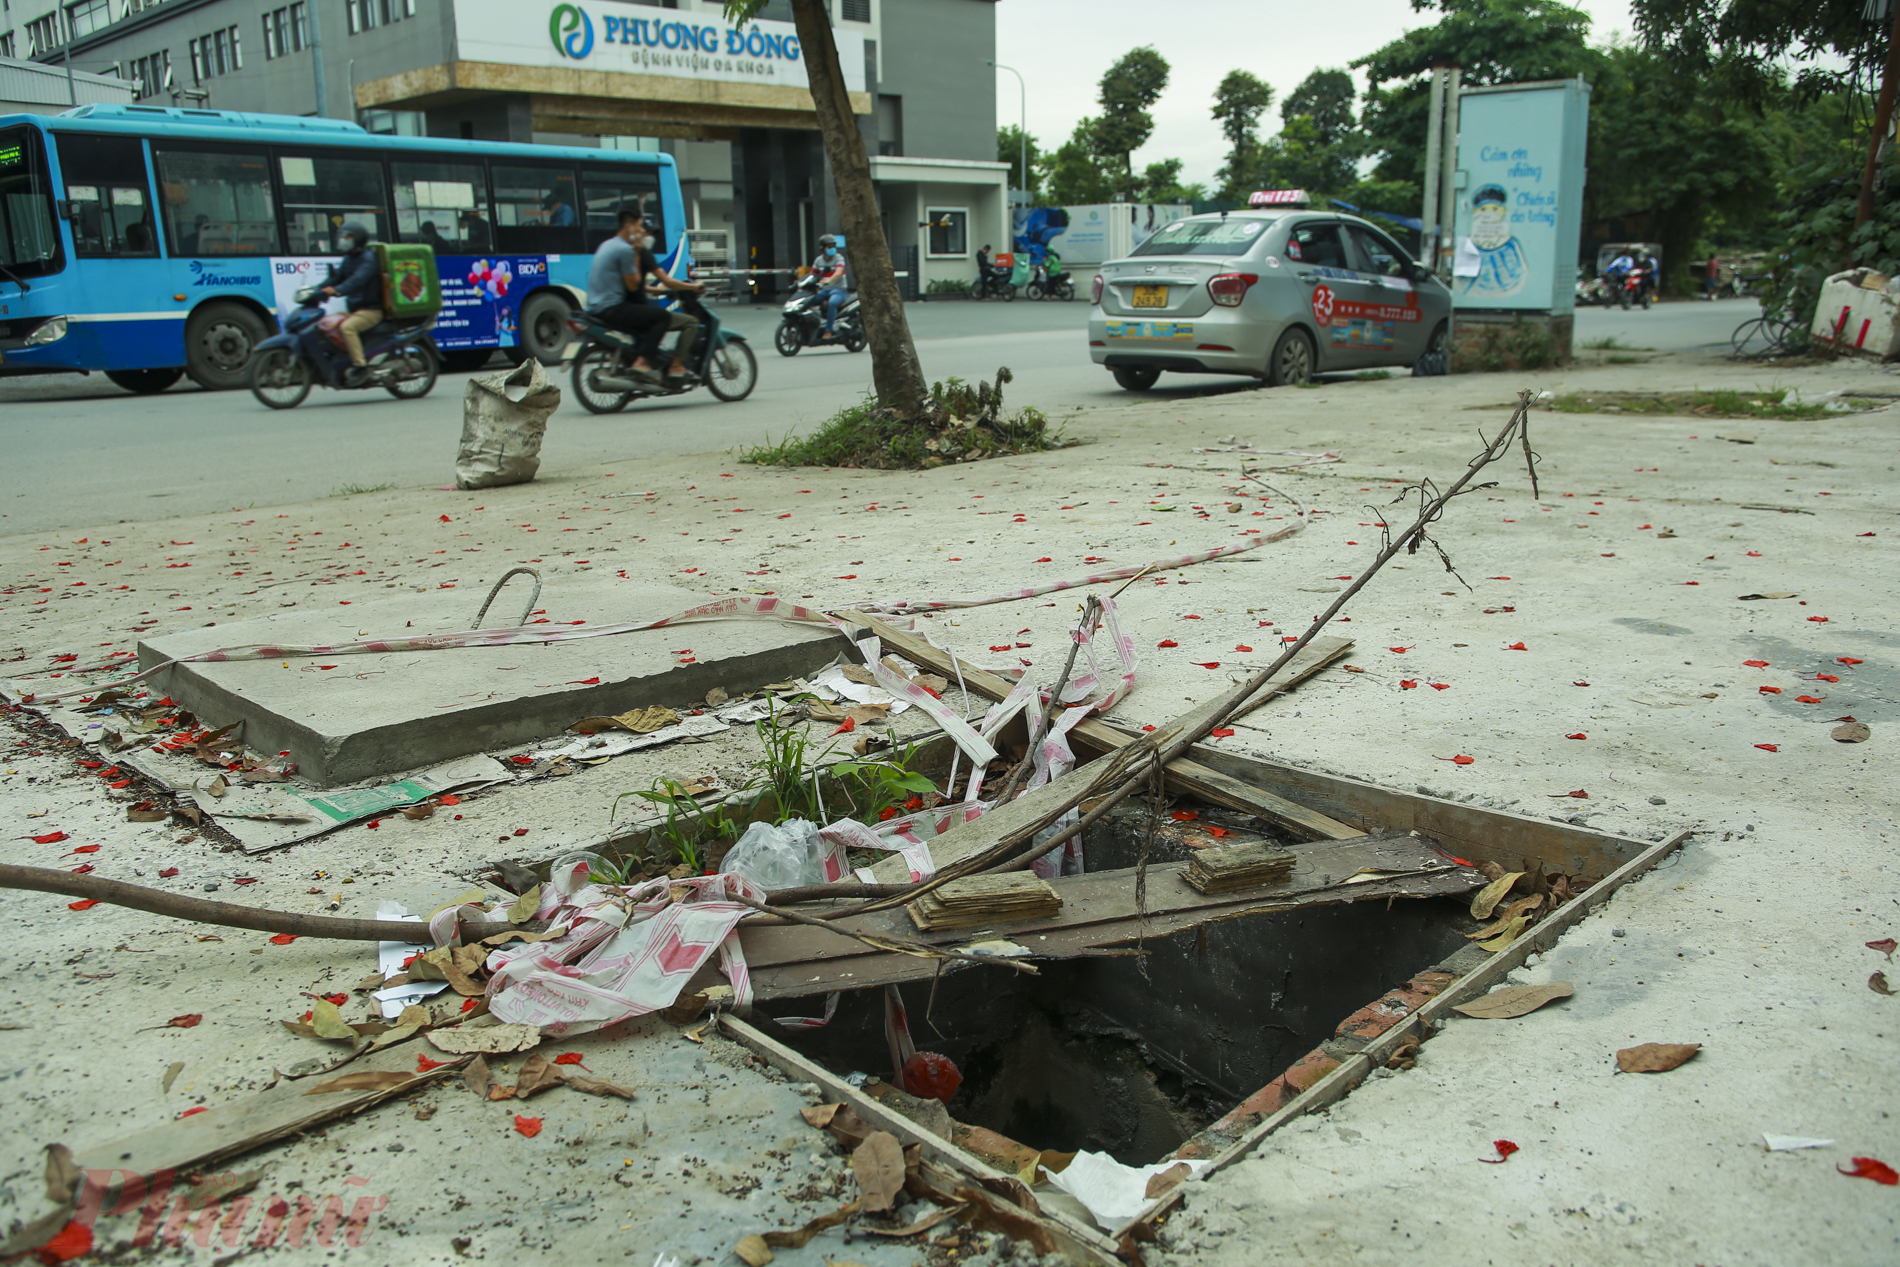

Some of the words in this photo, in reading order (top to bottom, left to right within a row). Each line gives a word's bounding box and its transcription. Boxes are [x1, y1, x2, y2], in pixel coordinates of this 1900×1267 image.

[603, 15, 718, 52] PHƯƠNG
[726, 24, 800, 60] ĐÔNG
[737, 61, 775, 75] KHOA
[1251, 191, 1275, 203] Taxi
[1275, 189, 1300, 203] 123
